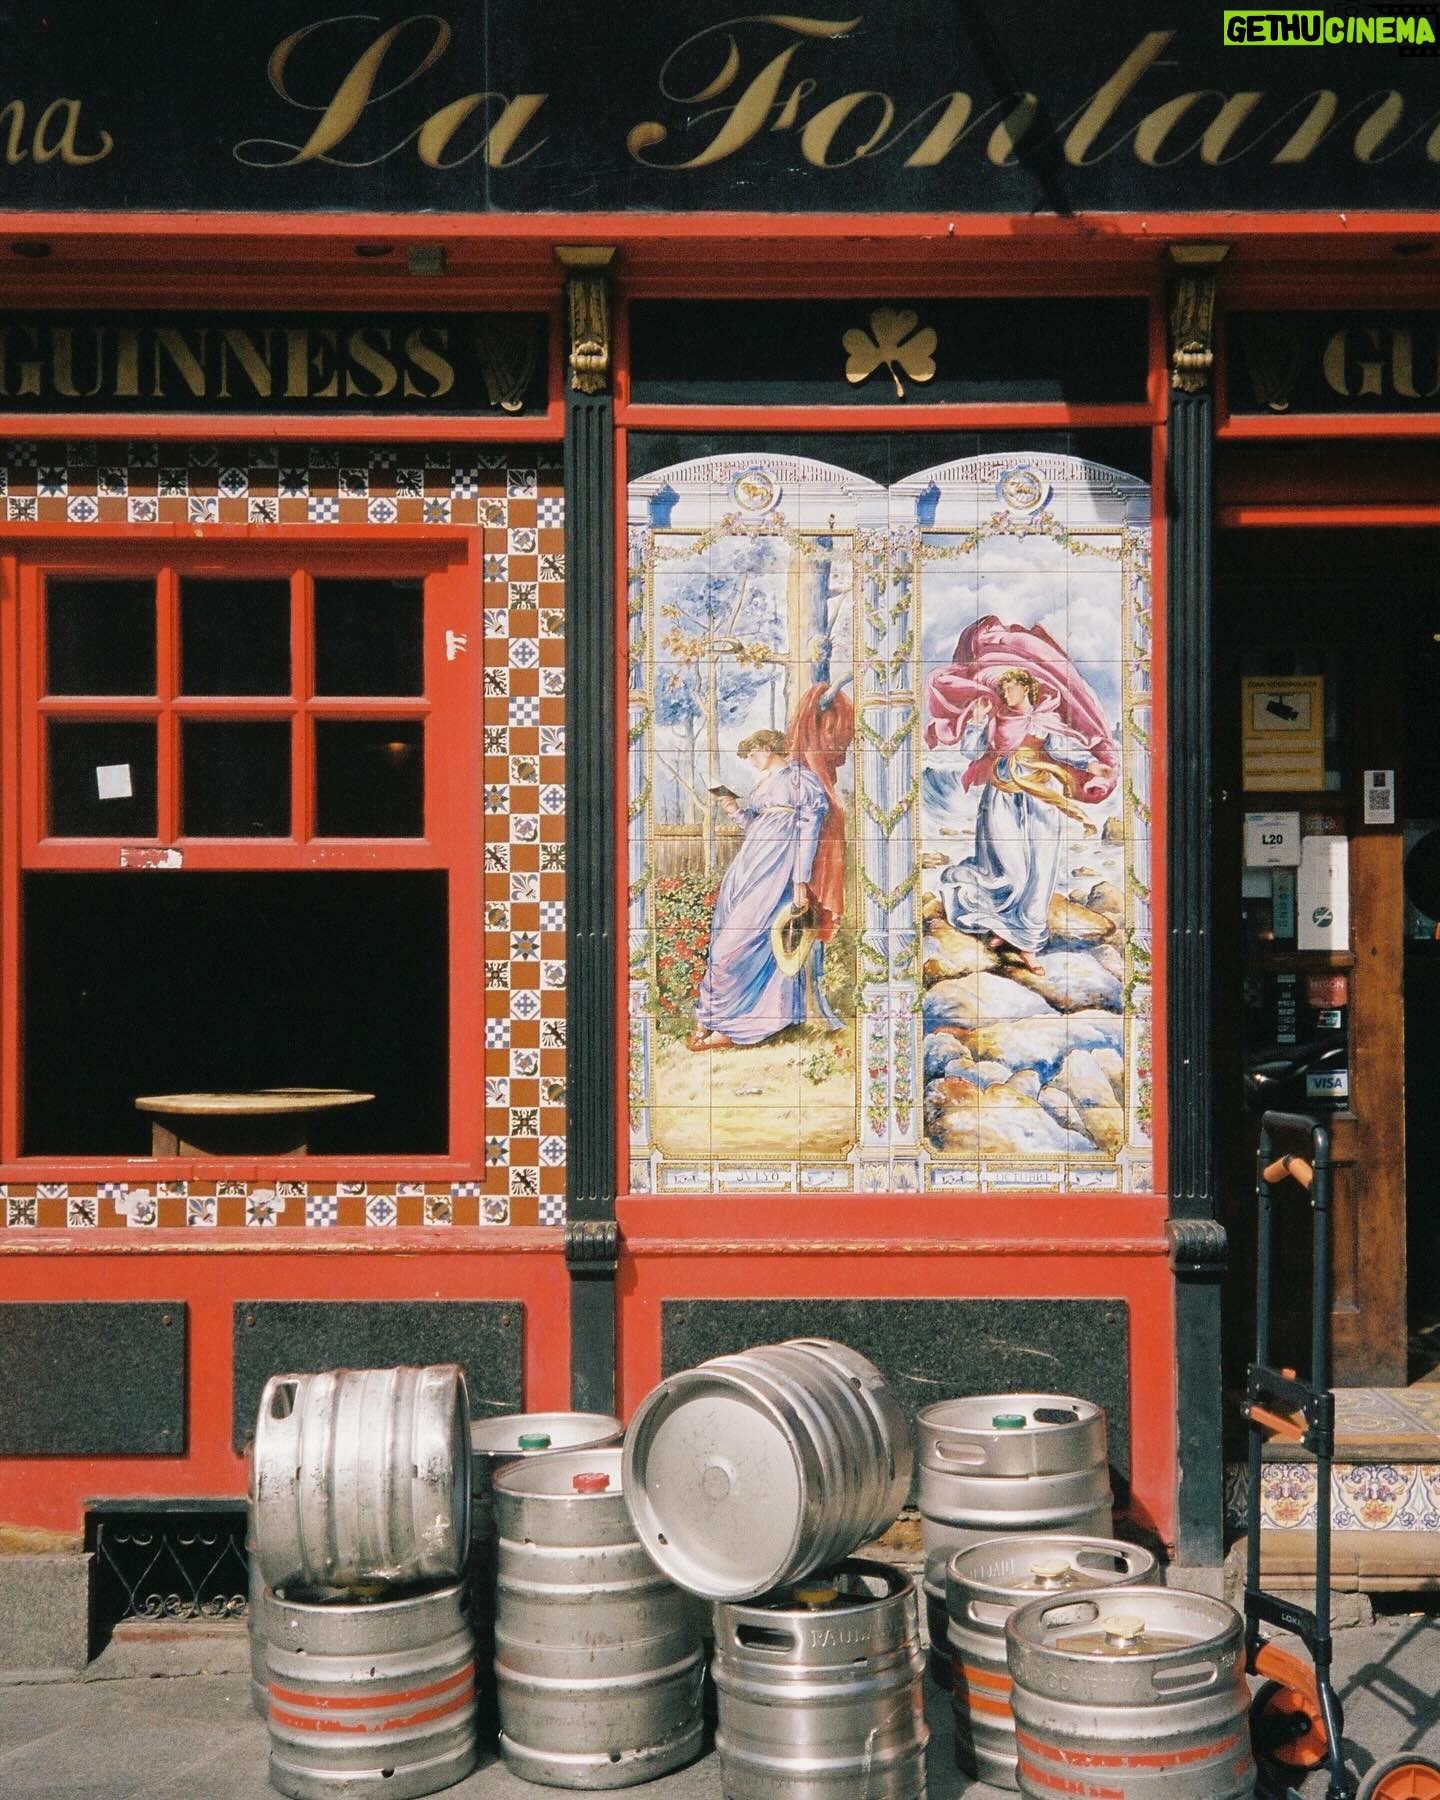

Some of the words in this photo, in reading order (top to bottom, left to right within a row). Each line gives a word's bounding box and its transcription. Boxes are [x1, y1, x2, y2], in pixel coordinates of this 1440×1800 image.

[233, 15, 549, 169] La
[627, 15, 1440, 170] Fontan
[0, 328, 456, 398] GUINNESS
[1262, 834, 1284, 845] L20
[1313, 1077, 1343, 1089] VISA
